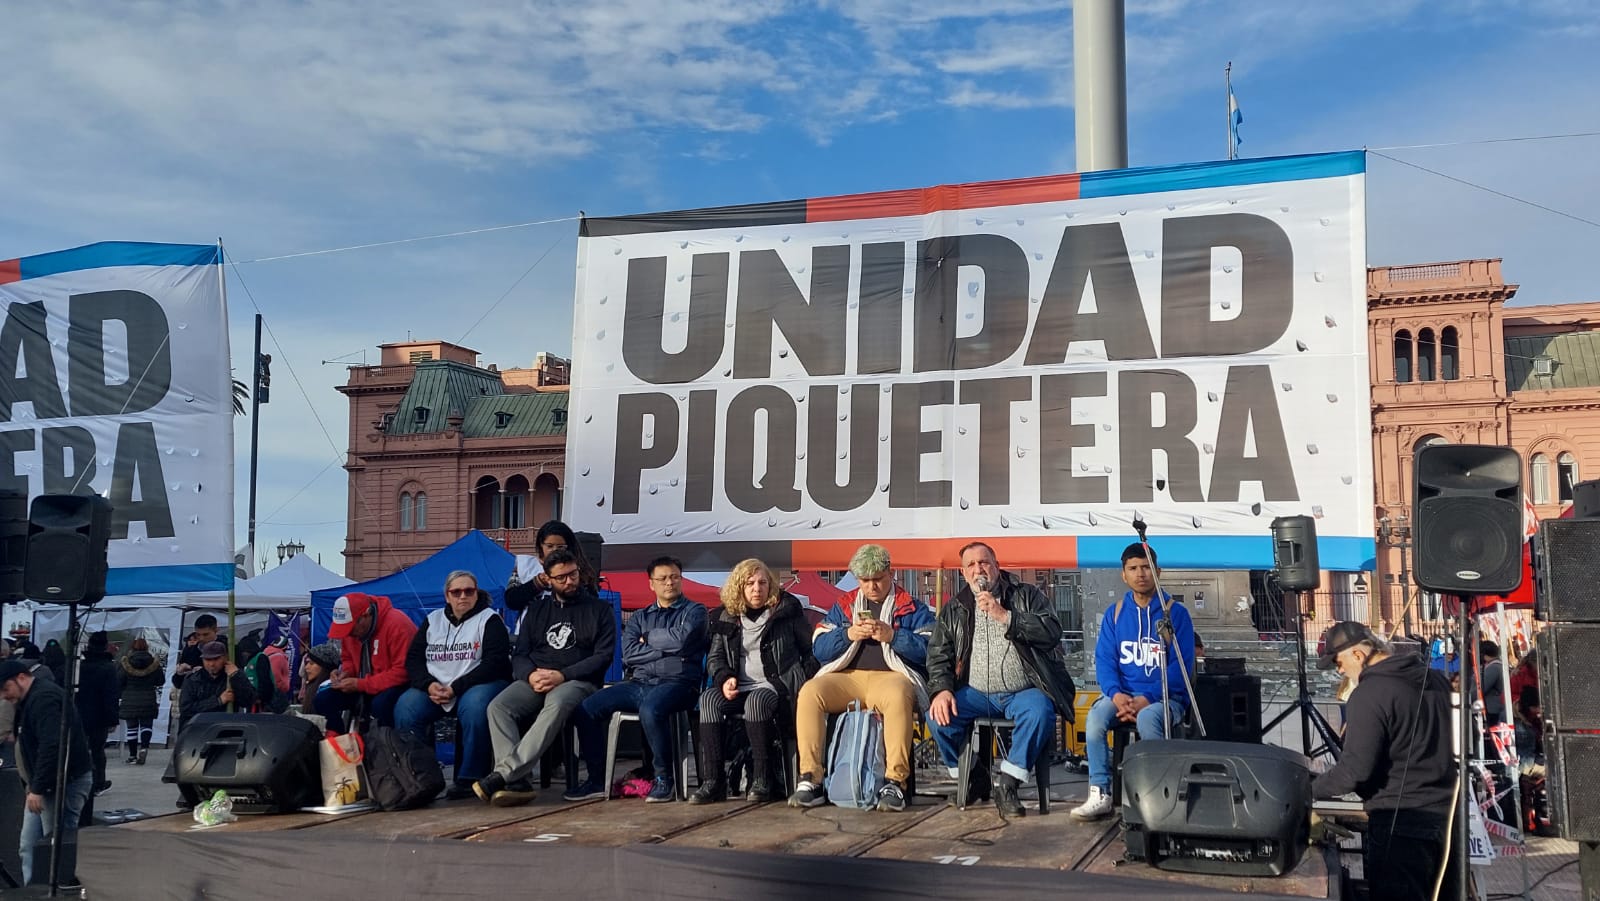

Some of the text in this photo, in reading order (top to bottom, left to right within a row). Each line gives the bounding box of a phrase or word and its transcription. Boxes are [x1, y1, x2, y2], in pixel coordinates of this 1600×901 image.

[621, 213, 1294, 384] UNIDAD
[611, 364, 1300, 514] PIQUETERA
[455, 651, 476, 661] SOCIAL
